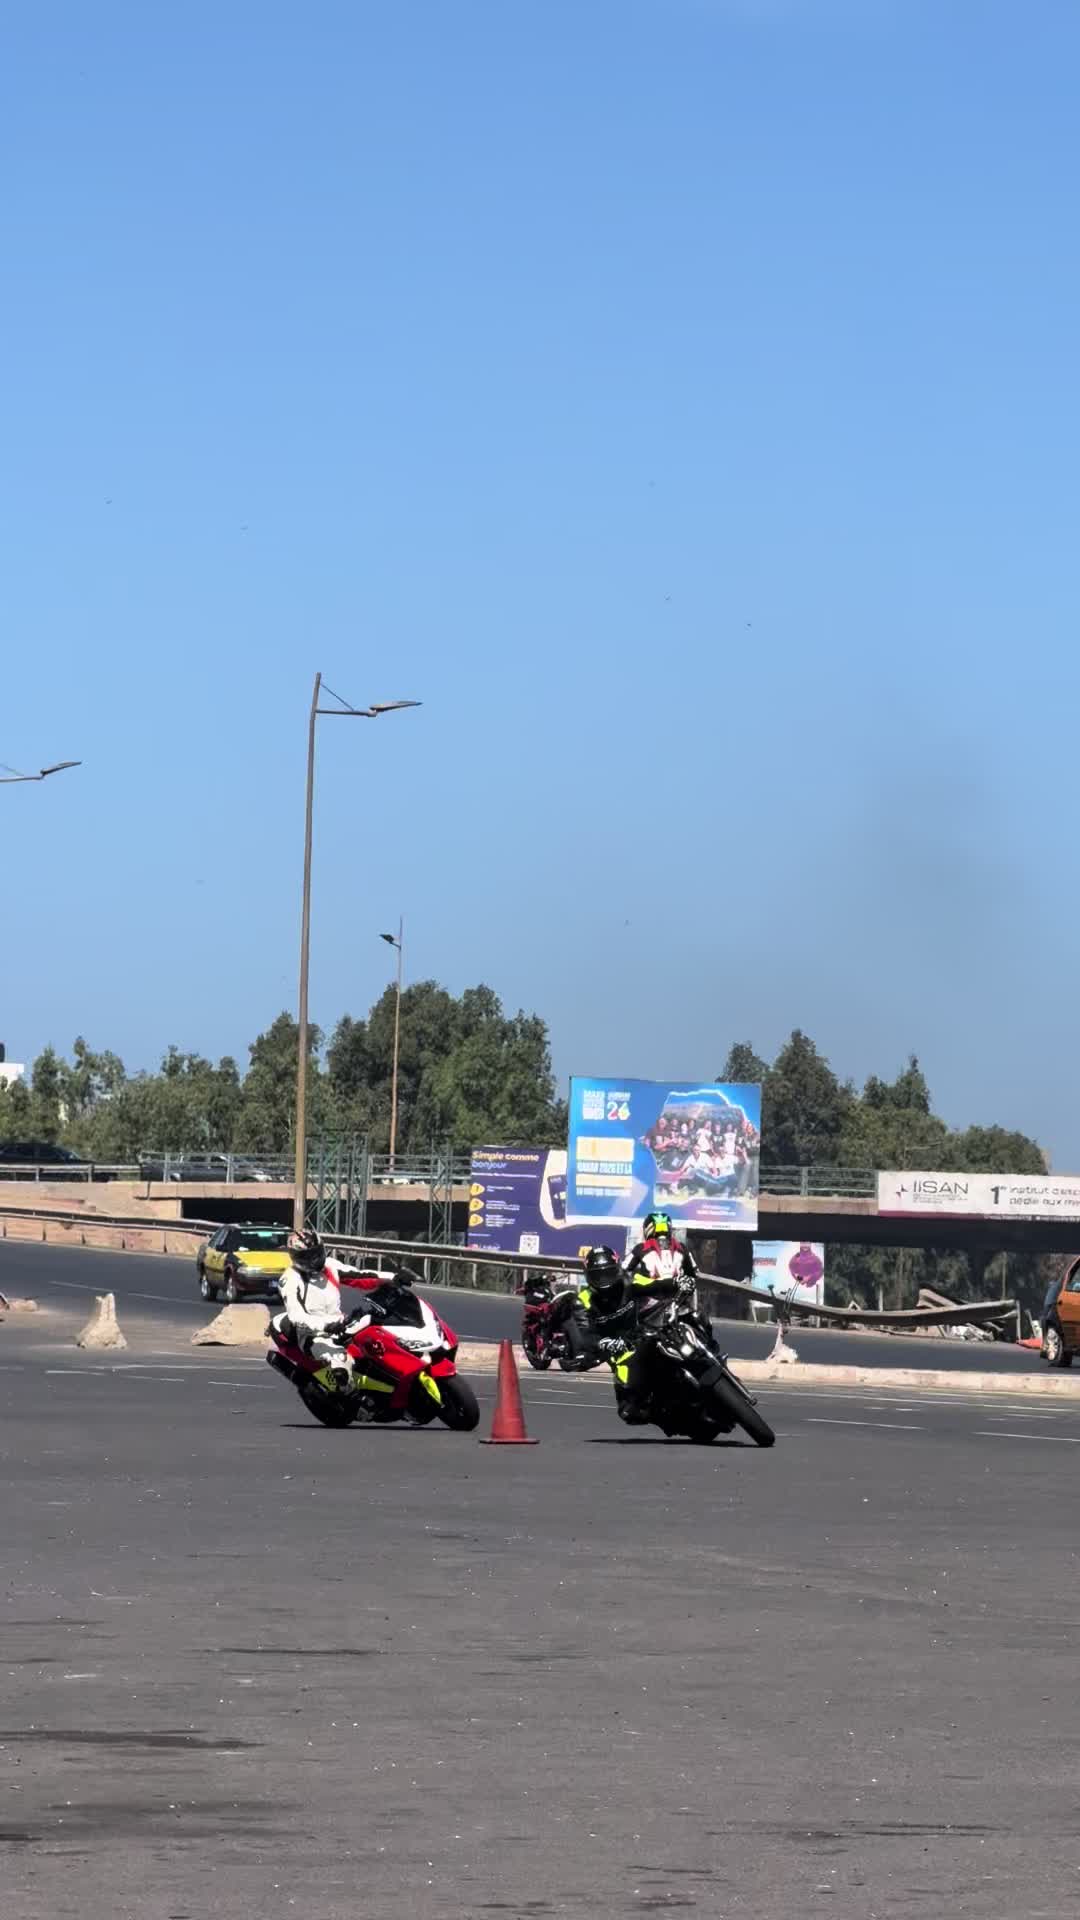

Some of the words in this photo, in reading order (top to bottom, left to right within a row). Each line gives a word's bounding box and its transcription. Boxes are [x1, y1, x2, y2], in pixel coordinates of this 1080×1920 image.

[472, 1151, 504, 1161] Simple
[505, 1153, 539, 1161] comme
[472, 1160, 507, 1170] bonjour
